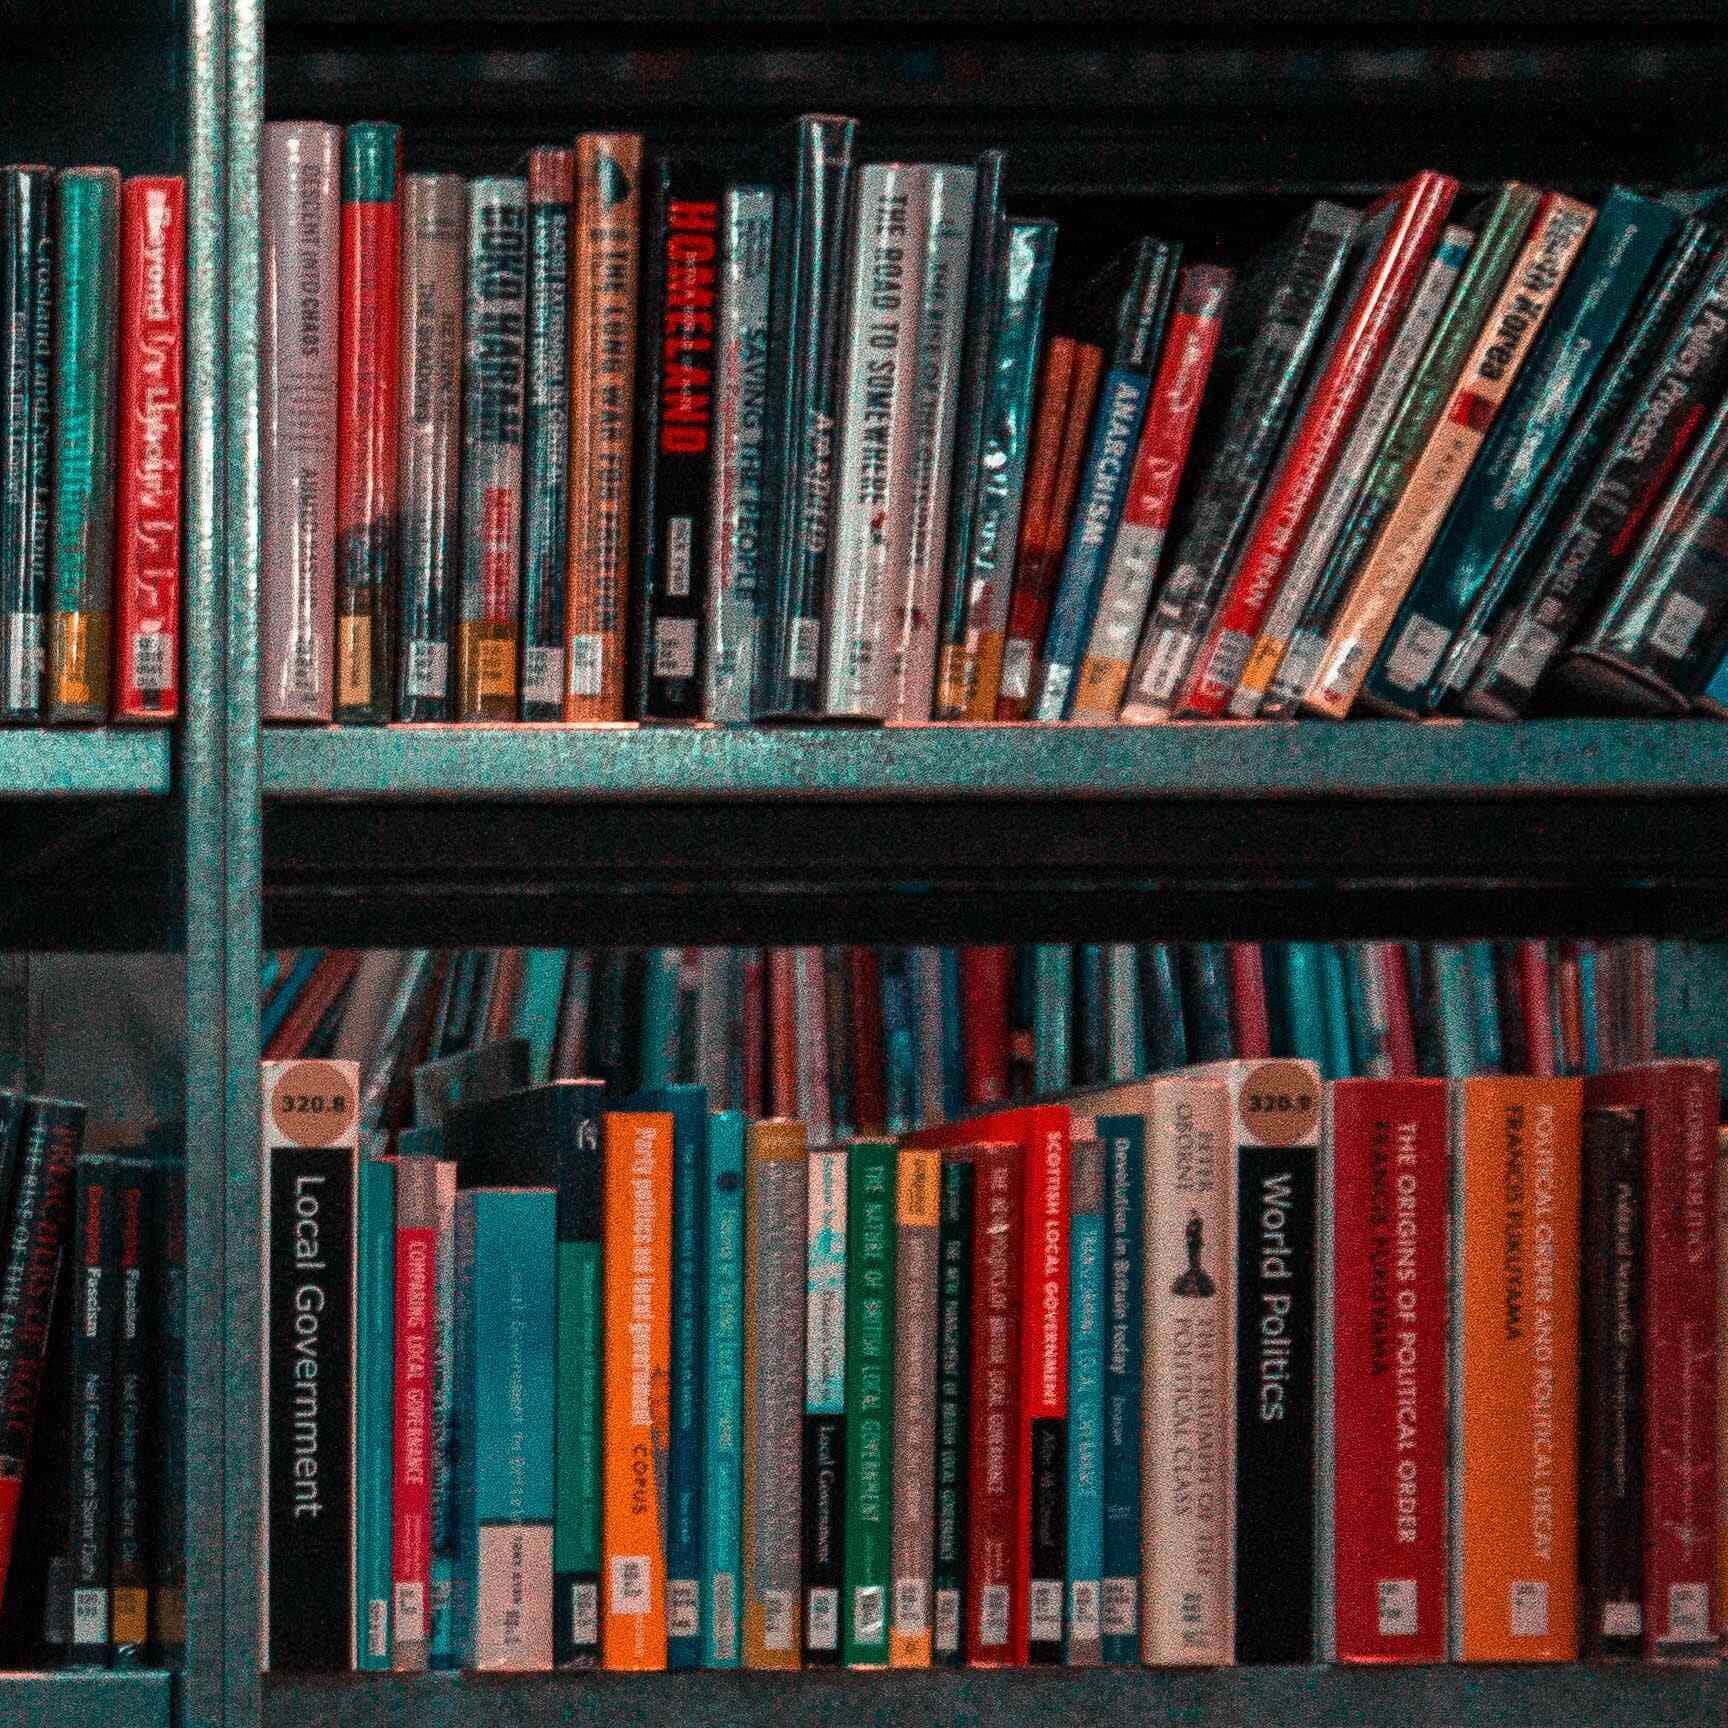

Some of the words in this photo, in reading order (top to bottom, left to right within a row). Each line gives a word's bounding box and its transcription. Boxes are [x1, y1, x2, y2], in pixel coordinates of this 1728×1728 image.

[301, 165, 320, 245] DESCENT
[878, 194, 908, 236] THE
[301, 251, 320, 293] INTO
[871, 247, 904, 310] ROAD
[301, 297, 320, 356] CHAOS
[661, 201, 718, 454] HOMELAND
[868, 323, 899, 350] TO
[1478, 295, 1544, 384] Korea
[741, 328, 765, 426] SAVING
[860, 360, 897, 504] SOMEWHERE
[1623, 377, 1691, 463] Process
[740, 439, 764, 489] THE
[1081, 382, 1142, 545] ANARCHISM
[668, 556, 689, 592] ryan
[669, 520, 690, 551] nick
[737, 500, 762, 602] PEOPLE
[1044, 1131, 1061, 1212] SCOTTISH
[1396, 1122, 1417, 1165] THE
[294, 1175, 326, 1269] Local
[1043, 1217, 1060, 1276] LOCAL
[1261, 1173, 1292, 1279] World
[1396, 1174, 1417, 1281] ORIGINS
[1042, 1282, 1059, 1406] GOVERNMENT
[1396, 1291, 1417, 1322] OF
[1261, 1293, 1292, 1421] Politics
[1396, 1330, 1418, 1450] POLITICAL
[292, 1284, 326, 1518] Government
[1396, 1460, 1418, 1543] ORDER
